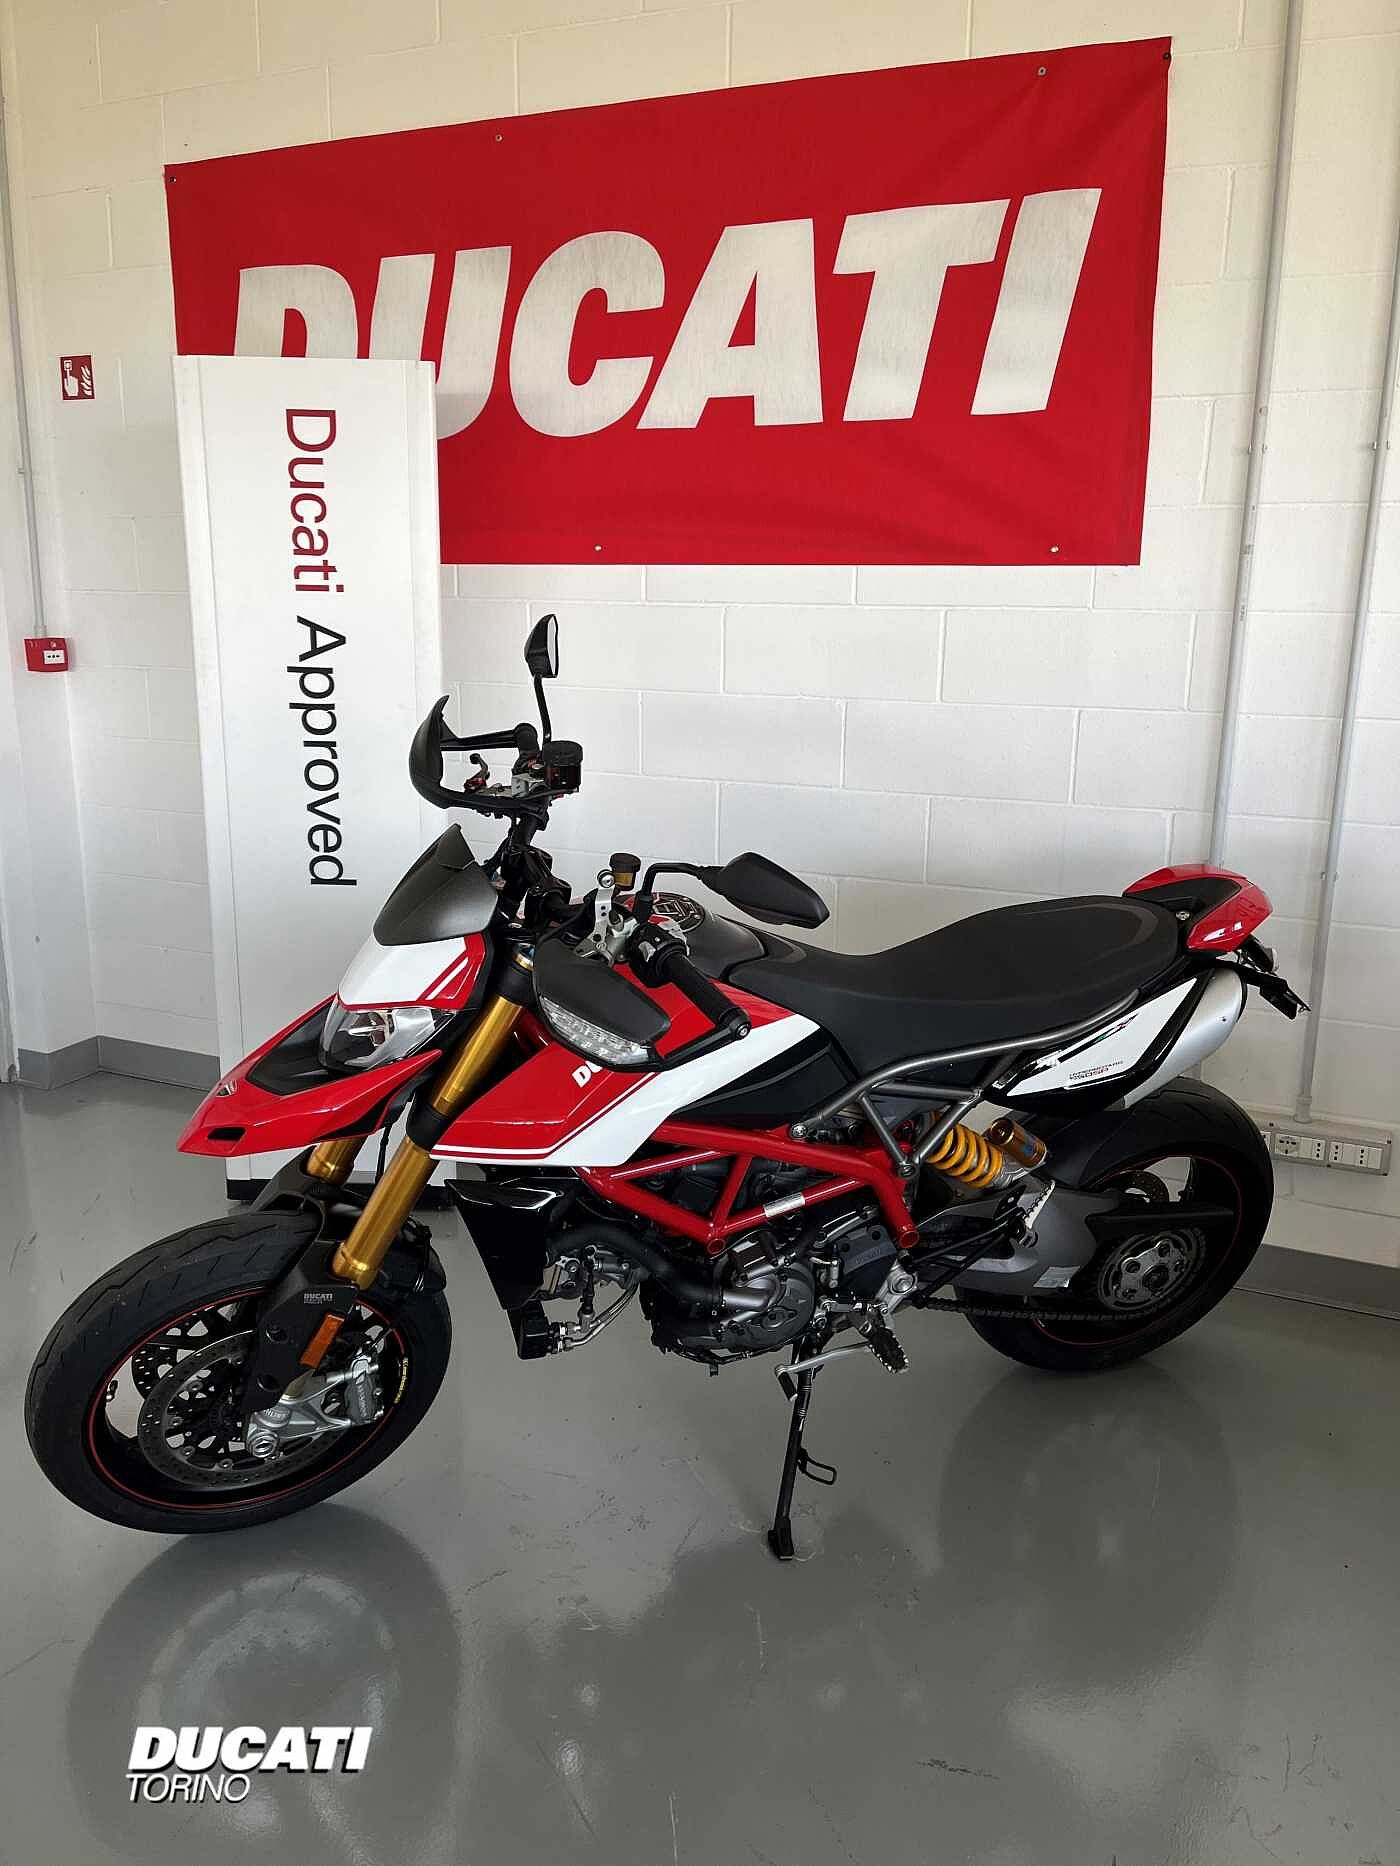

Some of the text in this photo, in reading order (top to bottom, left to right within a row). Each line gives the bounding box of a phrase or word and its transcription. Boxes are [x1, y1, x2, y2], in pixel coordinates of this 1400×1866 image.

[235, 187, 1102, 440] DUCATI
[285, 408, 358, 887] Ducati Approved
